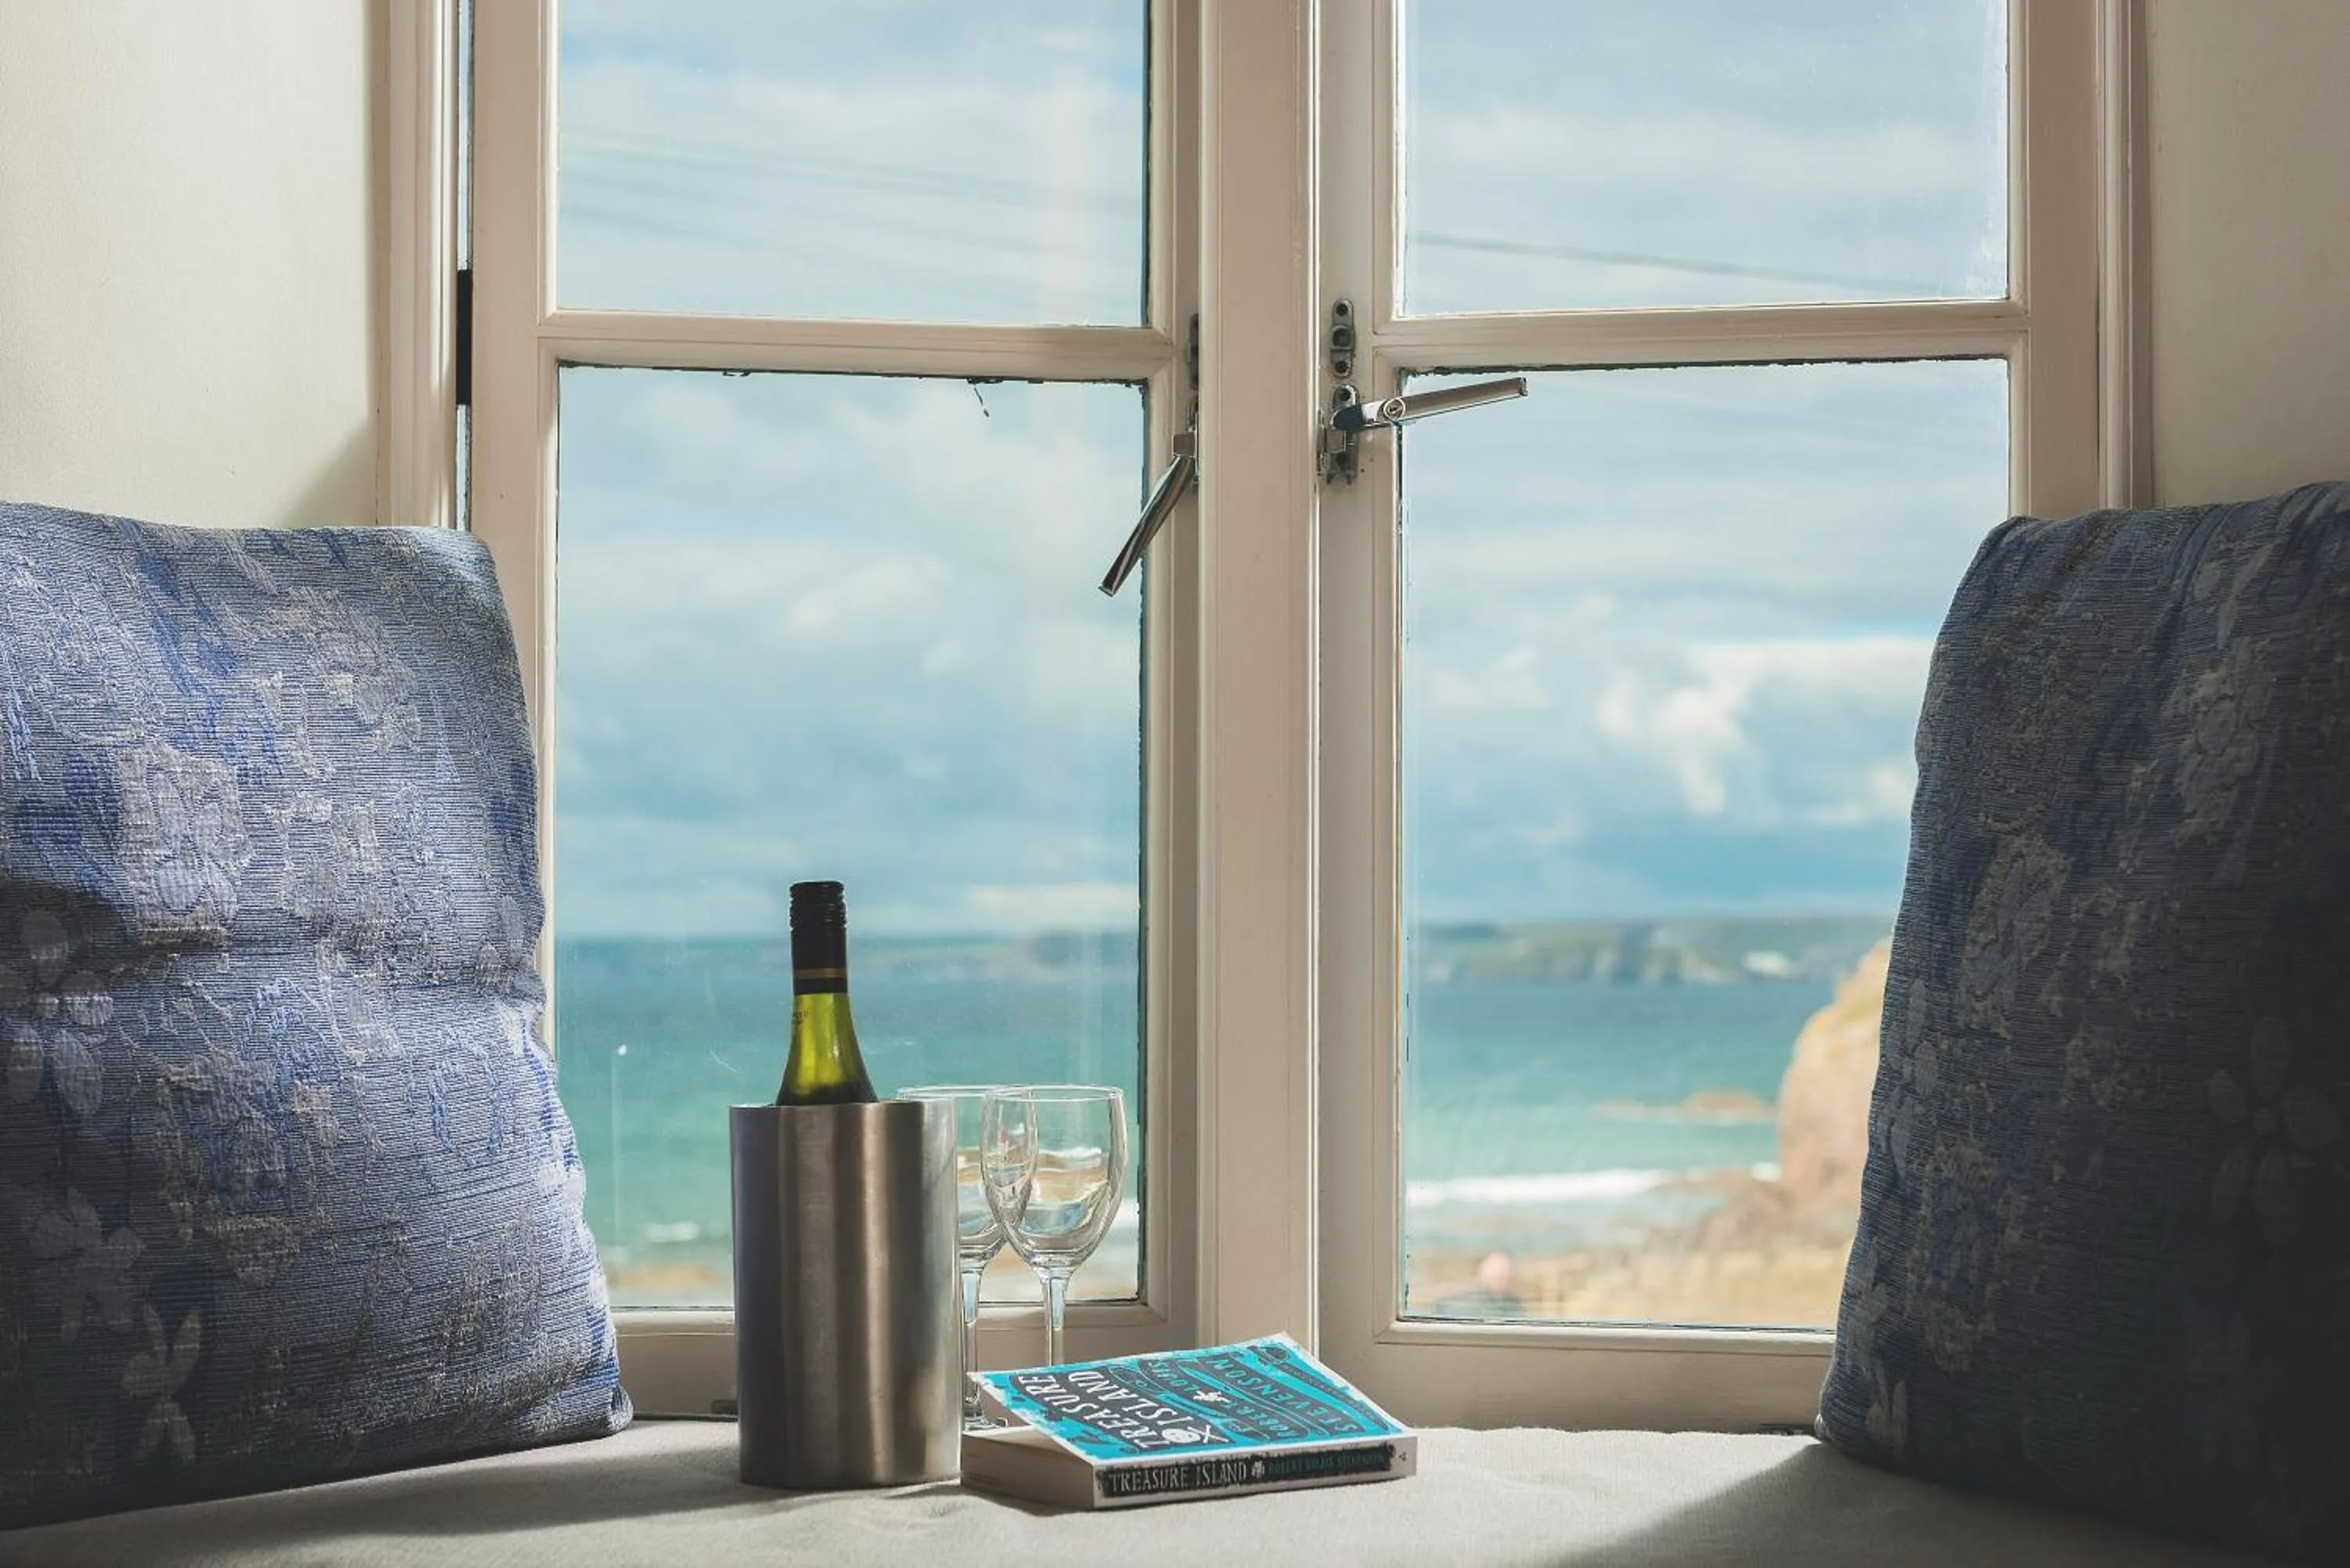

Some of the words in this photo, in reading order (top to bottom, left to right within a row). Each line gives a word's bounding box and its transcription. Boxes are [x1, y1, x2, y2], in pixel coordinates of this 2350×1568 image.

[1068, 1371, 1193, 1425] ISLAND
[1148, 1360, 1198, 1392] LOUIS
[1206, 1358, 1358, 1432] STEVENSON
[1018, 1375, 1170, 1448] TREASURE
[1220, 1402, 1300, 1438] ROBERT
[1108, 1469, 1189, 1493] TREASURE
[1196, 1461, 1247, 1487] ISLAND
